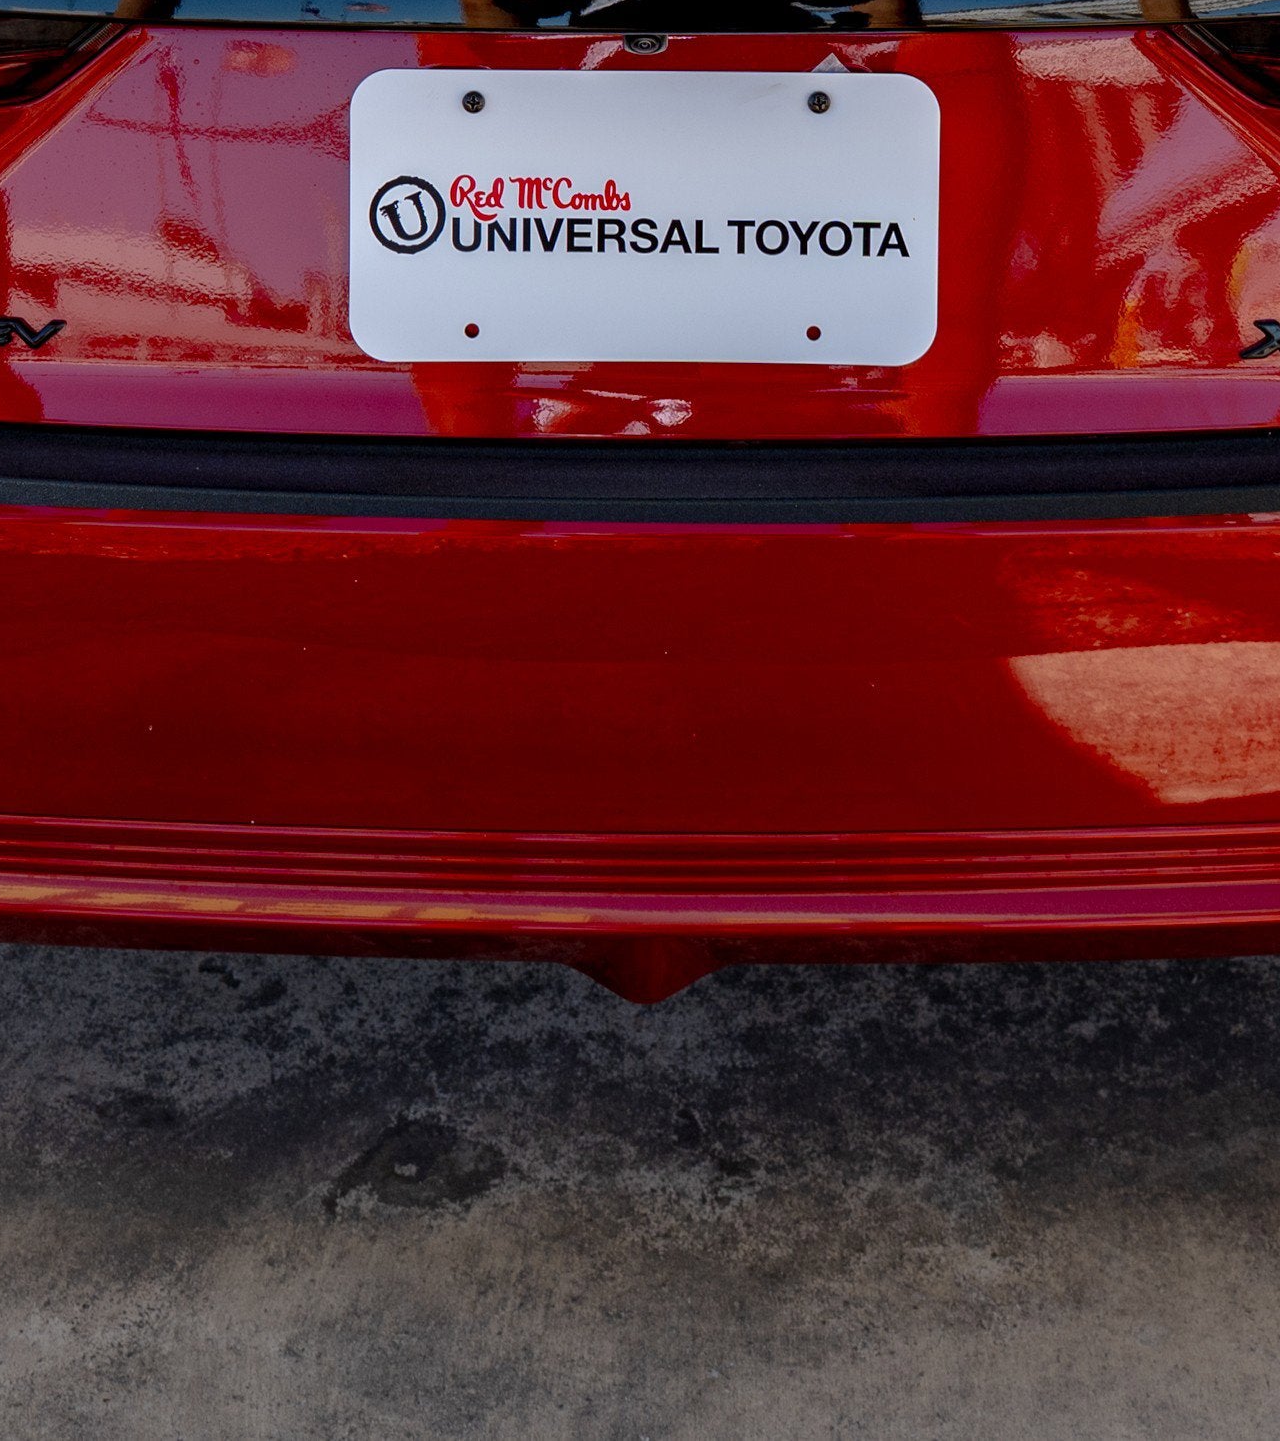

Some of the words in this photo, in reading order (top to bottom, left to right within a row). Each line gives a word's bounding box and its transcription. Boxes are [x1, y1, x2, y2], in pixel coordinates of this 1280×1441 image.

[449, 174, 504, 223] Red
[509, 175, 632, 213] McCombs
[451, 216, 720, 256] UNIVERSAL
[727, 218, 910, 258] TOYOTA
